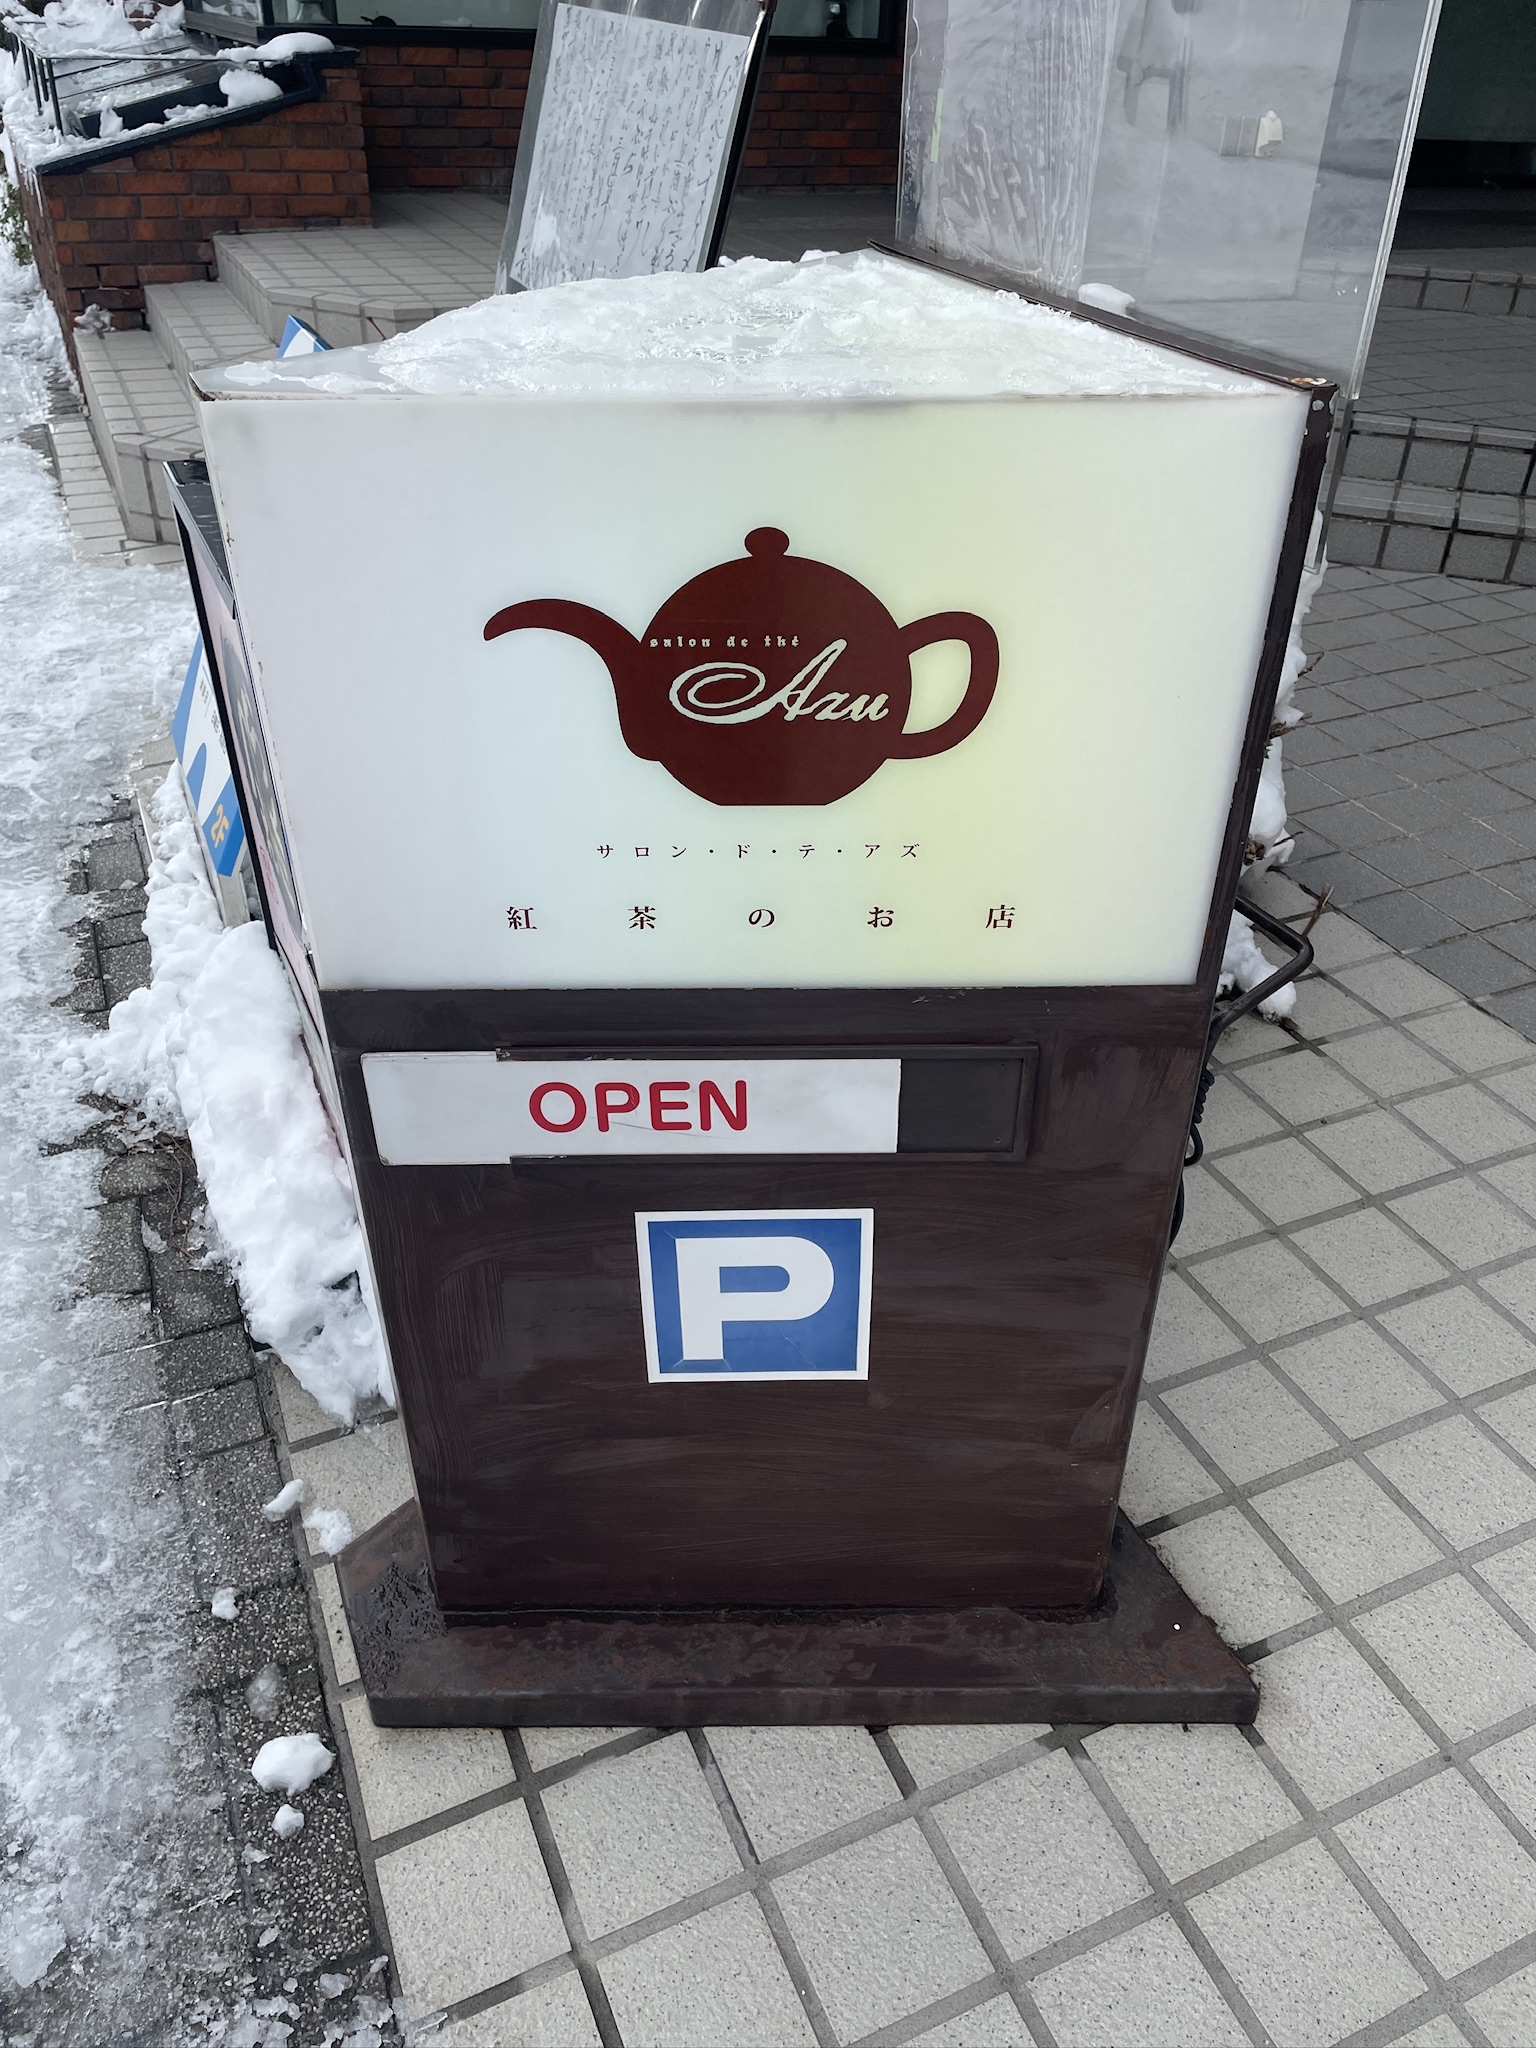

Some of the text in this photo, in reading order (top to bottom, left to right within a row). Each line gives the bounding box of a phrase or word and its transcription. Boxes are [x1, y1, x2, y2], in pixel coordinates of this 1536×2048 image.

[650, 635, 711, 648] salon
[727, 635, 749, 648] de
[669, 638, 889, 725] Azu
[506, 904, 1016, 931] 紅茶のお店
[529, 1079, 747, 1133] OPEN
[676, 1237, 835, 1361] P
